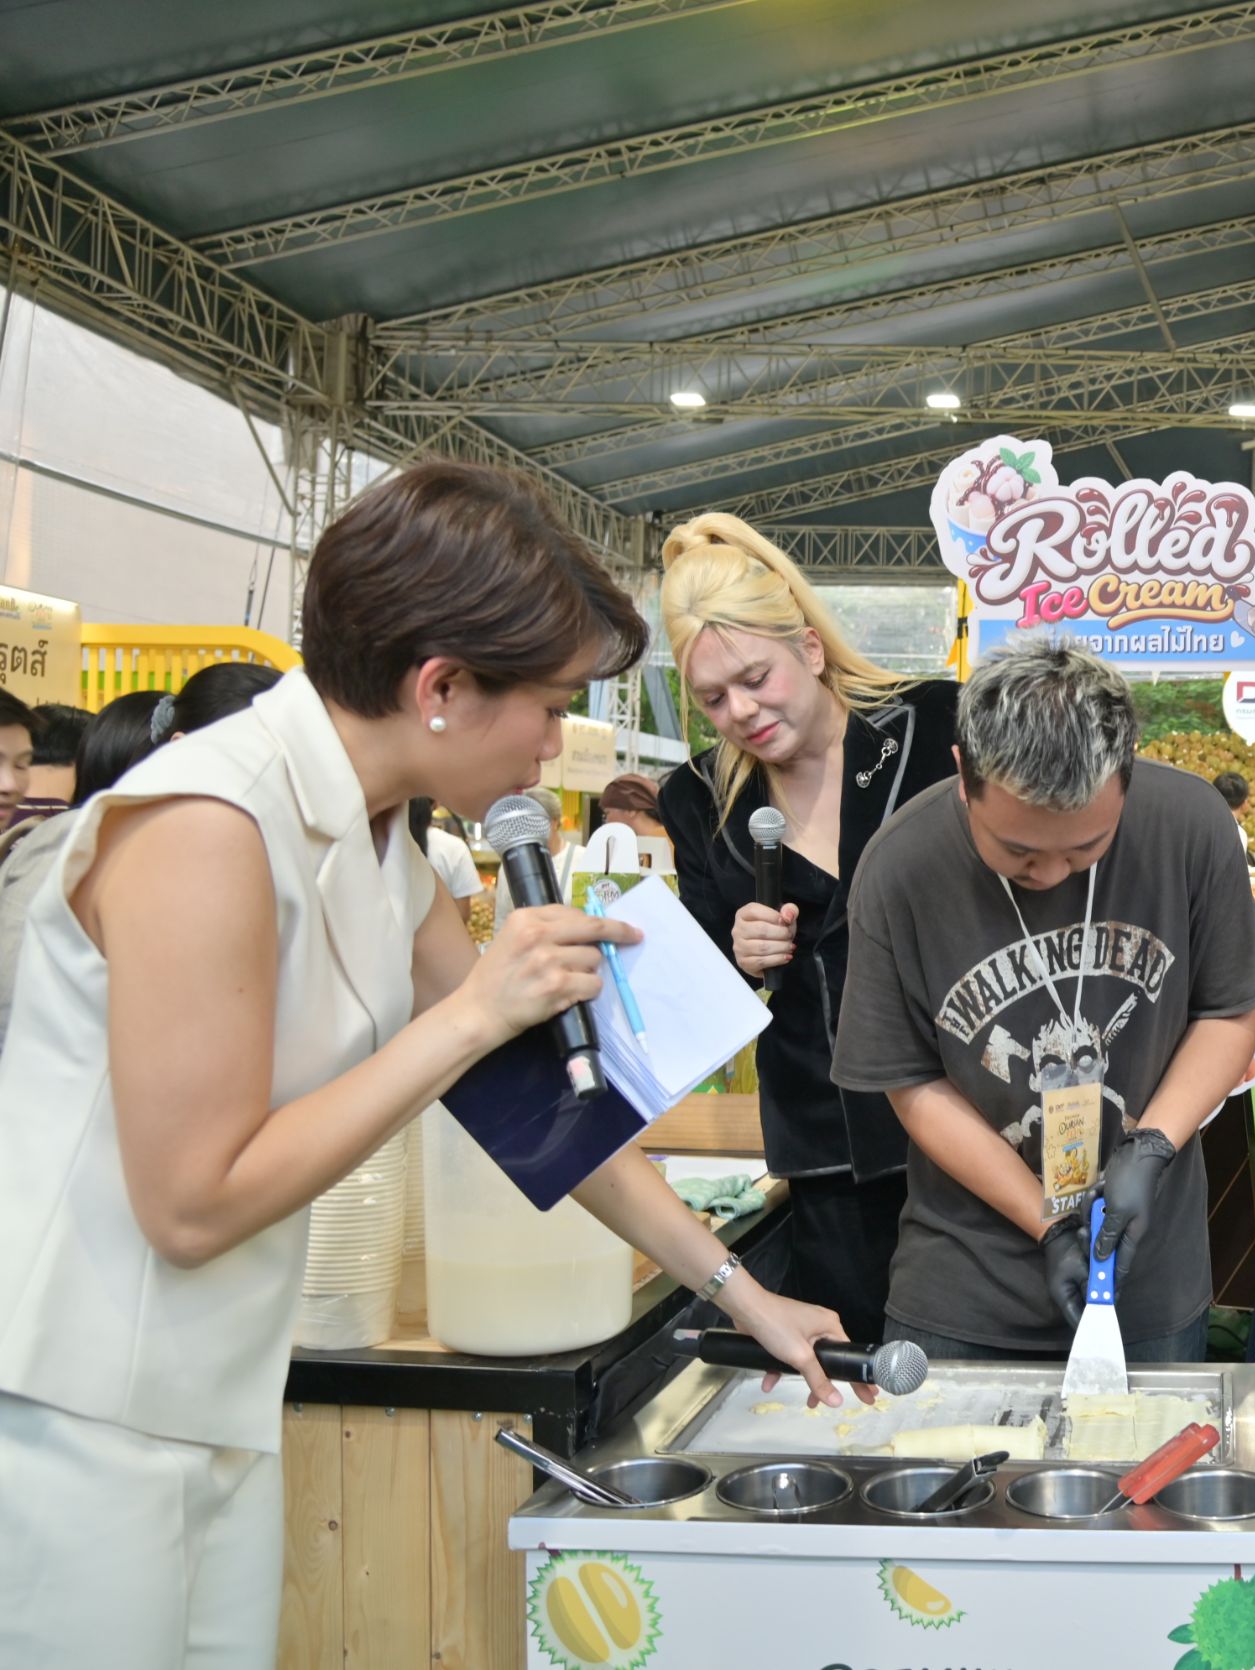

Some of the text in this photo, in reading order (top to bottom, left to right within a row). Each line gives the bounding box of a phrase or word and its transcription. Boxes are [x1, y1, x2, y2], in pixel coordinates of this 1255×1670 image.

[977, 489, 1255, 604] Rolled
[1017, 573, 1234, 629] Ice Cream
[1093, 926, 1168, 994] DEAD
[1051, 1191, 1086, 1214] STAF
